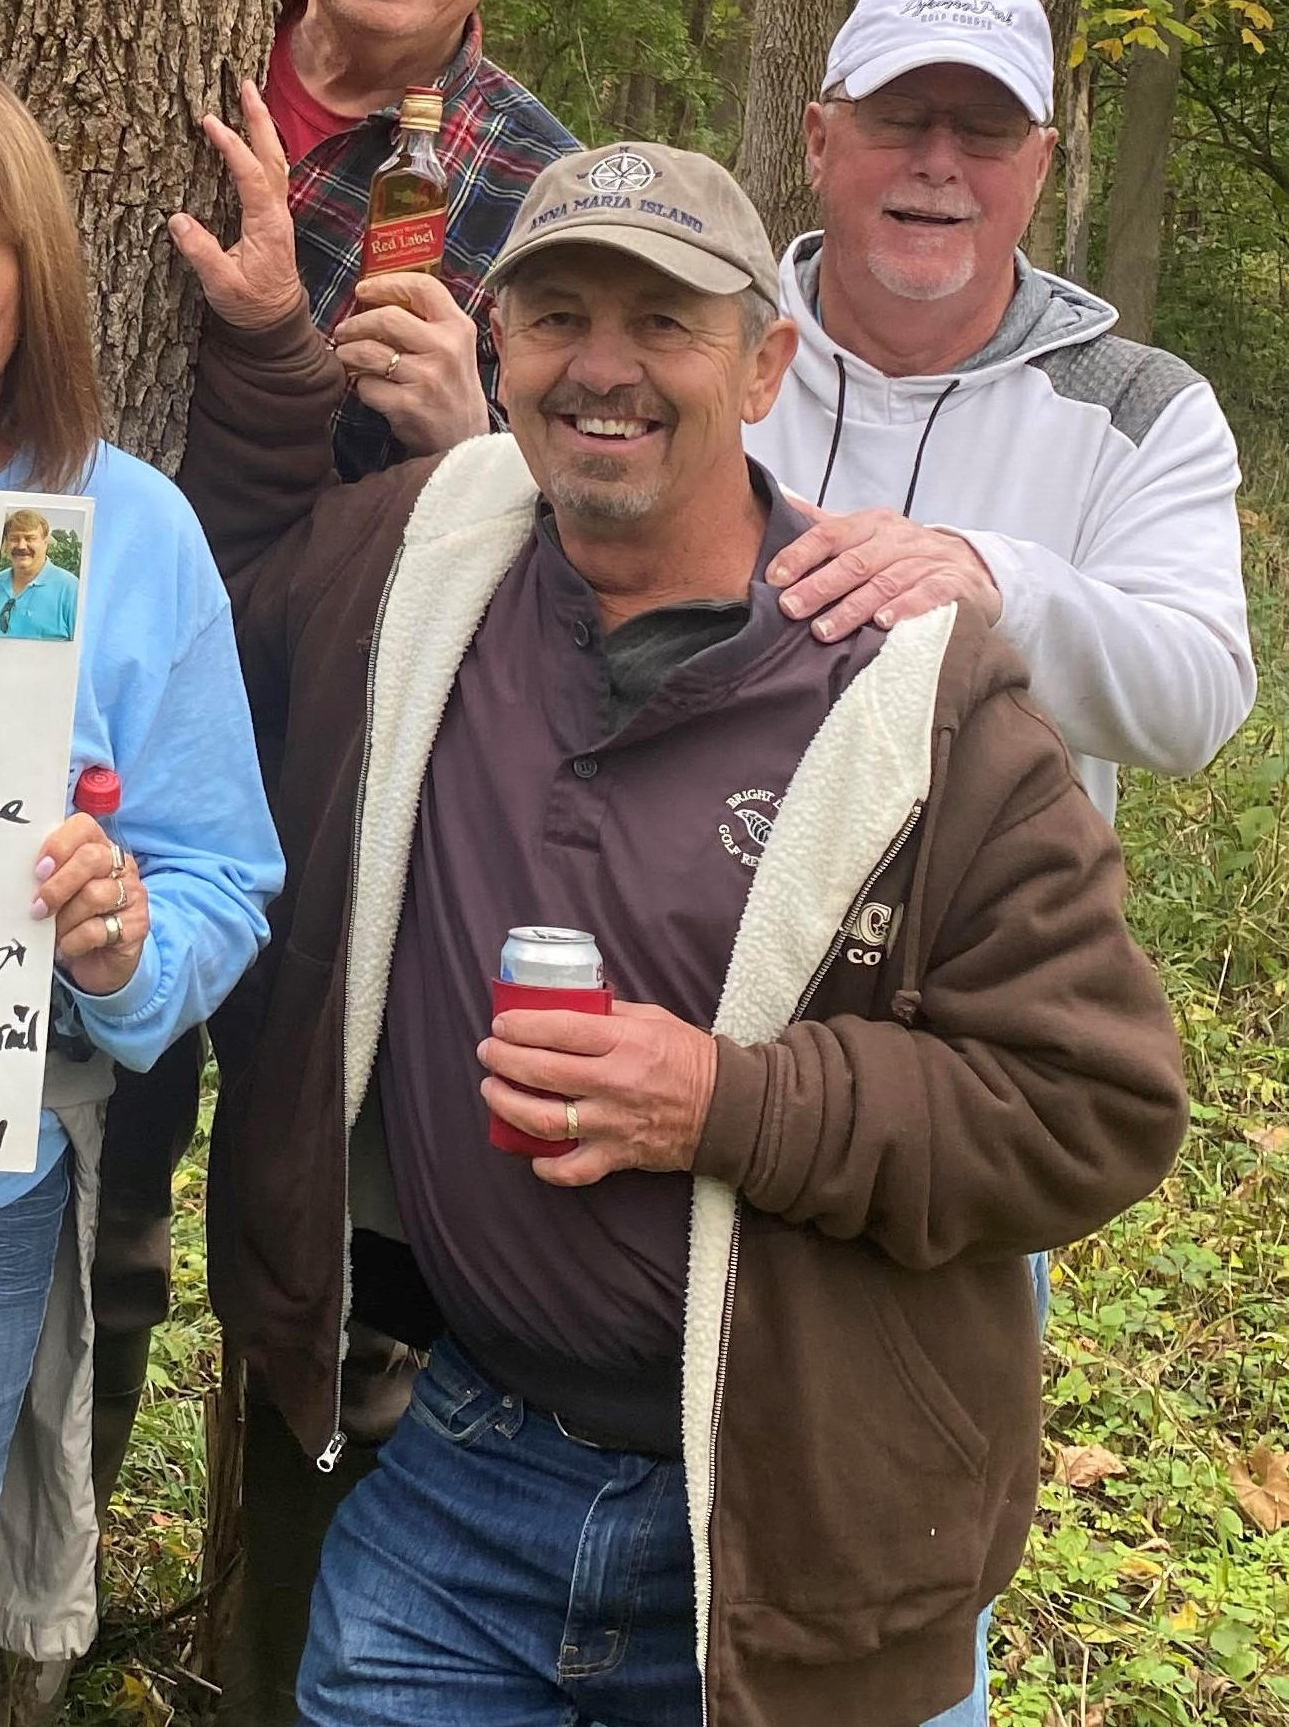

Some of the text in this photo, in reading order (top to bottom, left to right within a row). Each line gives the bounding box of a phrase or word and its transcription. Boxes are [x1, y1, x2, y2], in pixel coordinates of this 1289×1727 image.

[527, 195, 703, 234] ANNA MARIA ISLAND
[371, 238, 397, 254] Red
[398, 229, 435, 249] Label
[725, 788, 776, 810] BRIGHT
[718, 823, 741, 855] GOLF
